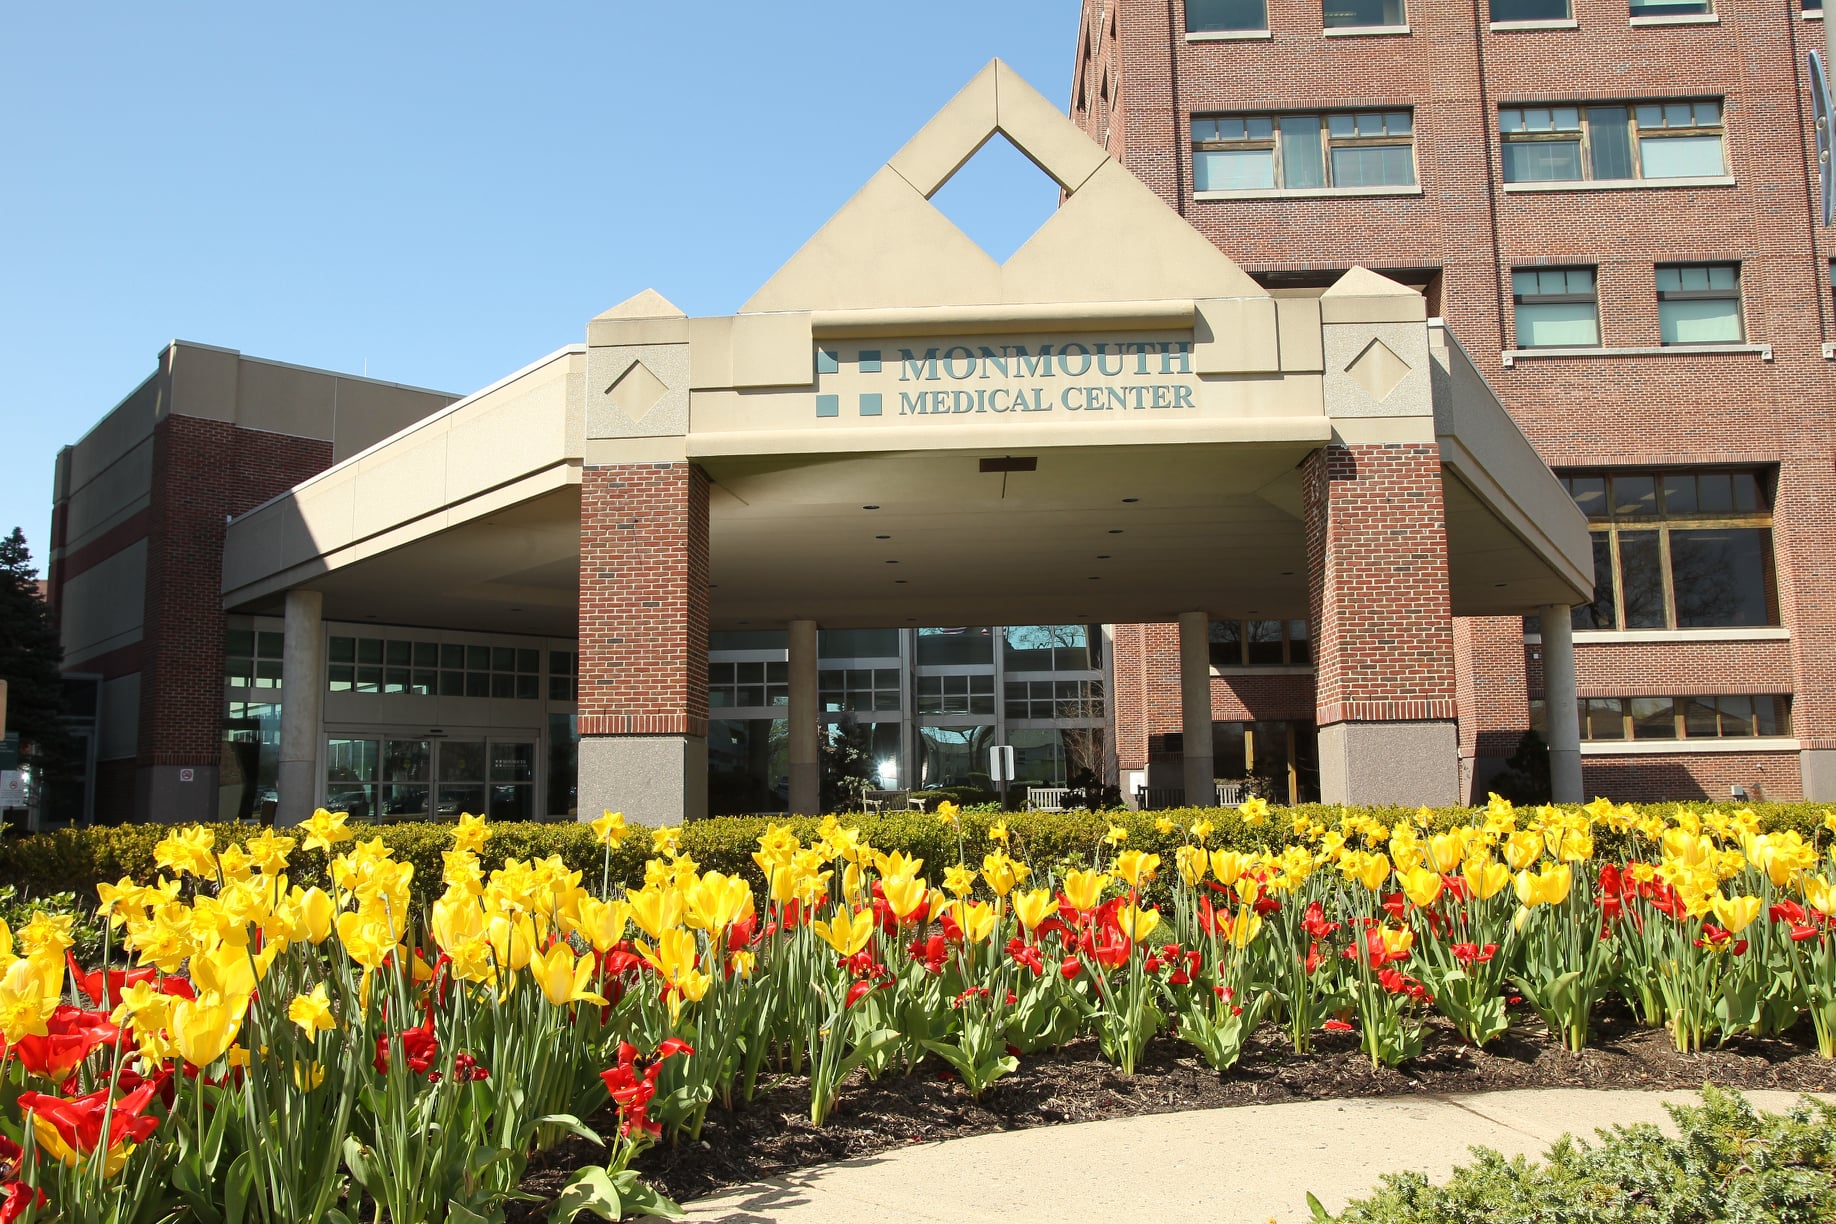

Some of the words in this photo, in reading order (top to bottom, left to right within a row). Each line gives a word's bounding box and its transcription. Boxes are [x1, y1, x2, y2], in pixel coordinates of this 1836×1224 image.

[898, 341, 1193, 381] MONMOUTH
[899, 388, 1053, 415] MEDICAL
[1061, 385, 1195, 411] CENTER
